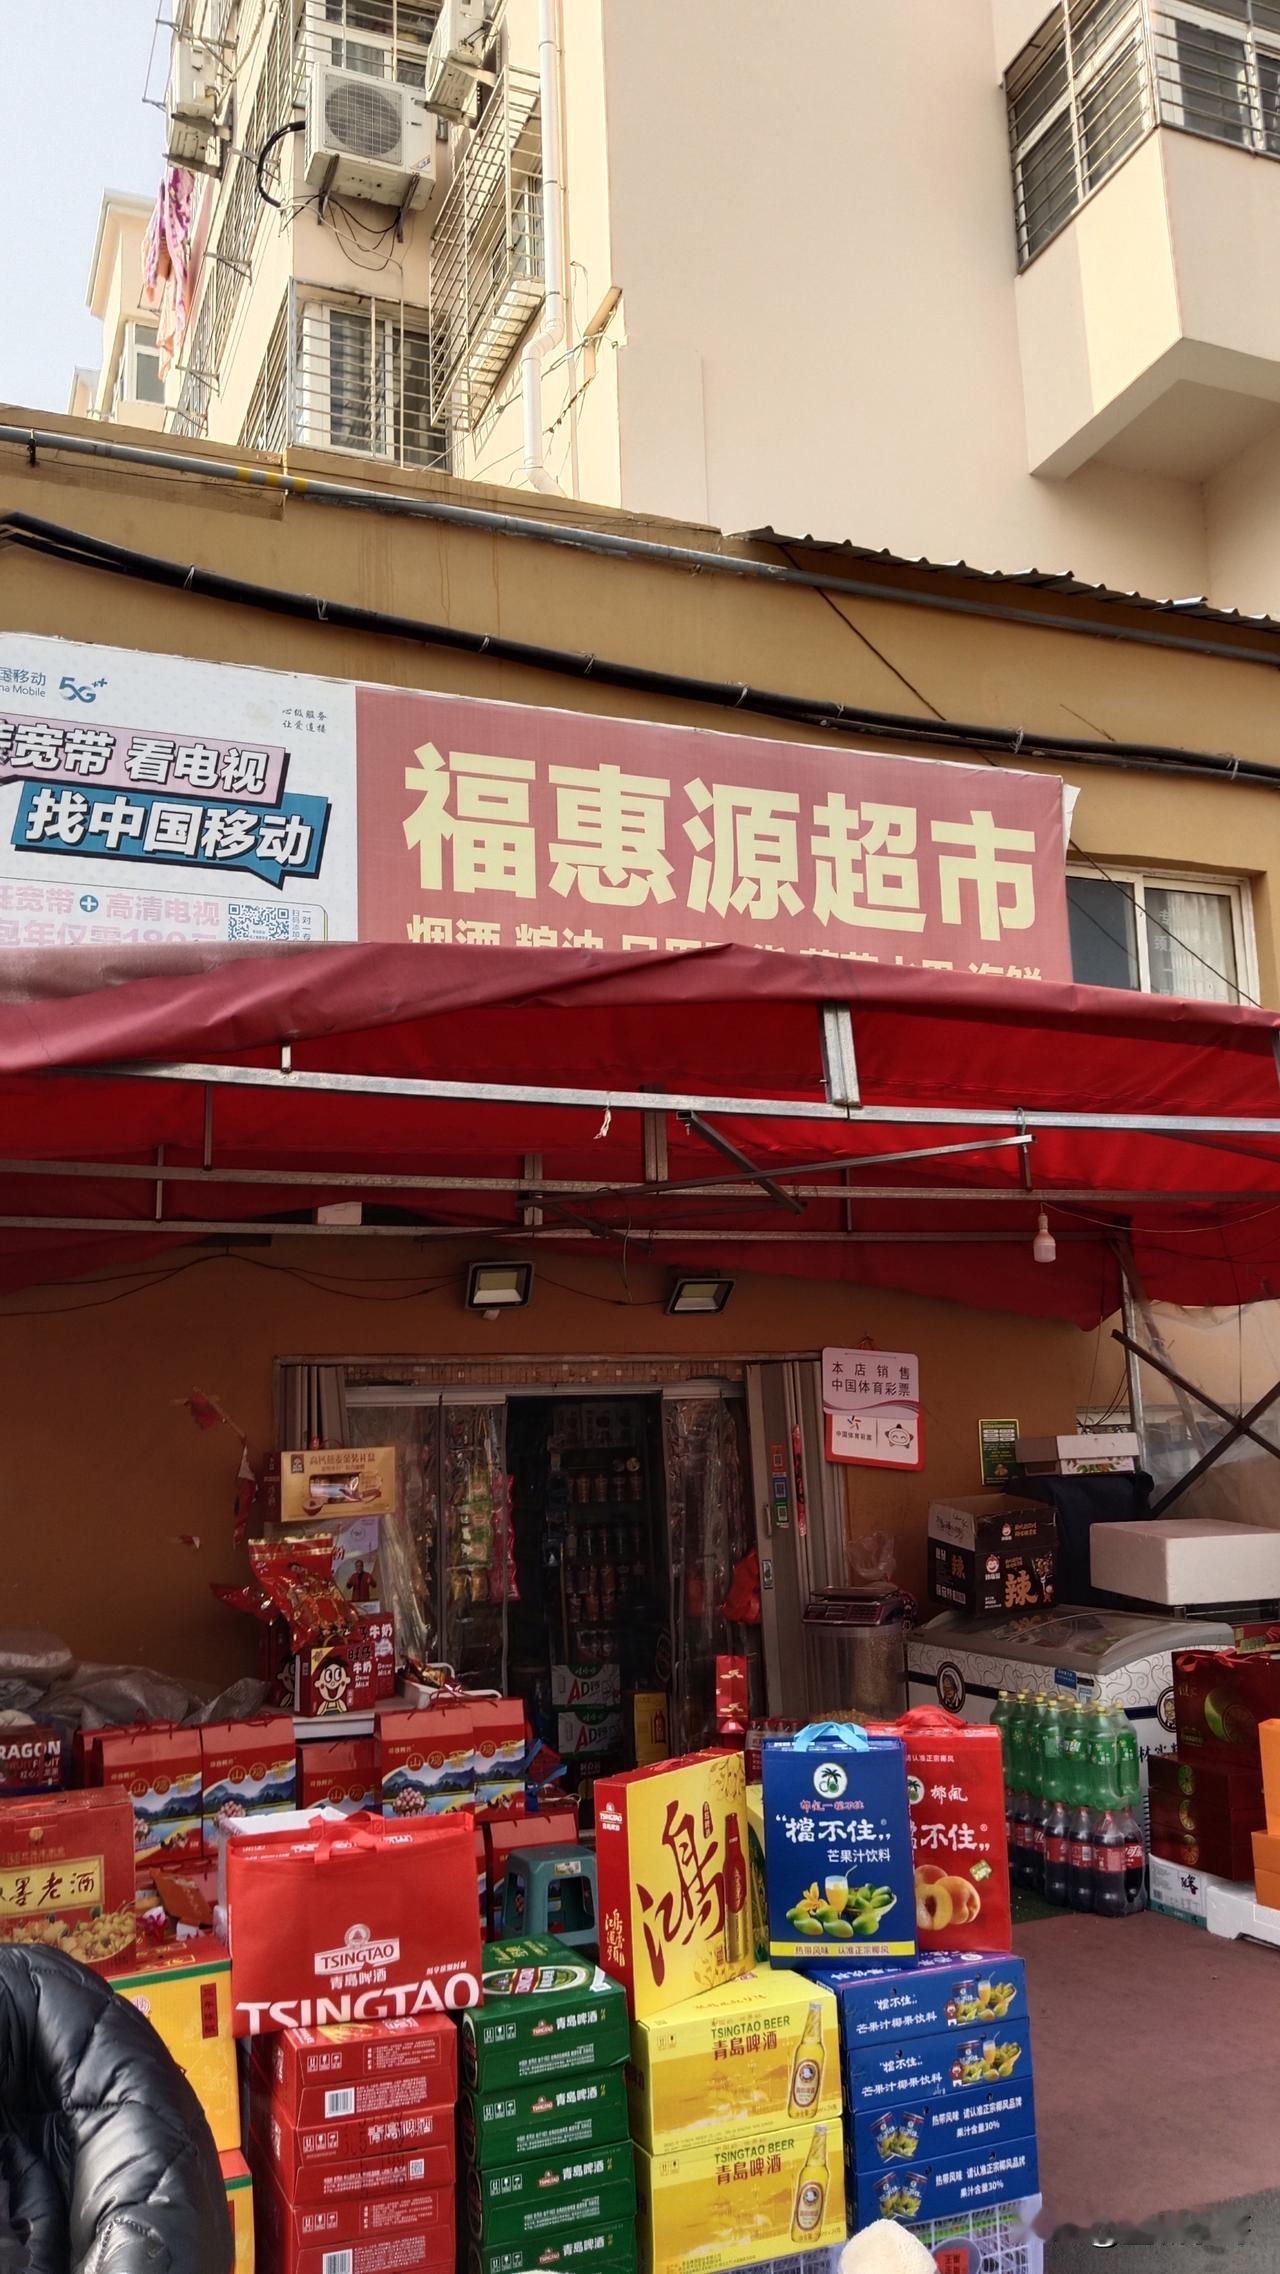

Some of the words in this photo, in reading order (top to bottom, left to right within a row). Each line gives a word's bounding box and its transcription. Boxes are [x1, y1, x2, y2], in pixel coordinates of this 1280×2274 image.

[12, 685, 46, 697] Mobile
[125, 736, 269, 794] 看电视
[25, 788, 313, 867] 找中国移动
[402, 742, 1036, 942] 福惠源超市
[105, 892, 221, 927] 高清电视
[831, 1360, 910, 1381] 本店销售
[831, 1377, 911, 1397] 中国体育彩票
[836, 1430, 873, 1441] 中国体育彩票
[1005, 1570, 1039, 1608] 辣
[369, 1623, 393, 1639] 牛奶
[353, 1660, 372, 1675] 牛奶
[827, 1848, 891, 1863] 芒果汁饮料
[321, 1944, 395, 1970] TSINGTAO
[235, 1972, 480, 2035] TSINGTAO
[711, 2020, 761, 2040] TSINGTAO
[763, 2014, 791, 2031] BEER
[856, 2011, 938, 2034] 芒果汁椰果饮料
[861, 2072, 943, 2097] 芒果汁椰果饮料
[932, 2110, 960, 2127] 热带风味
[963, 2096, 1023, 2119] 请认准正宗椰风品牌
[956, 2120, 1001, 2138] 果汁含量30%
[714, 2145, 766, 2165] TSINGTAO
[768, 2138, 795, 2154] BEER
[935, 2170, 963, 2187] 热带风味
[966, 2155, 1026, 2179] 请认准正宗椰风品牌
[960, 2179, 1004, 2199] 果汁含量30%
